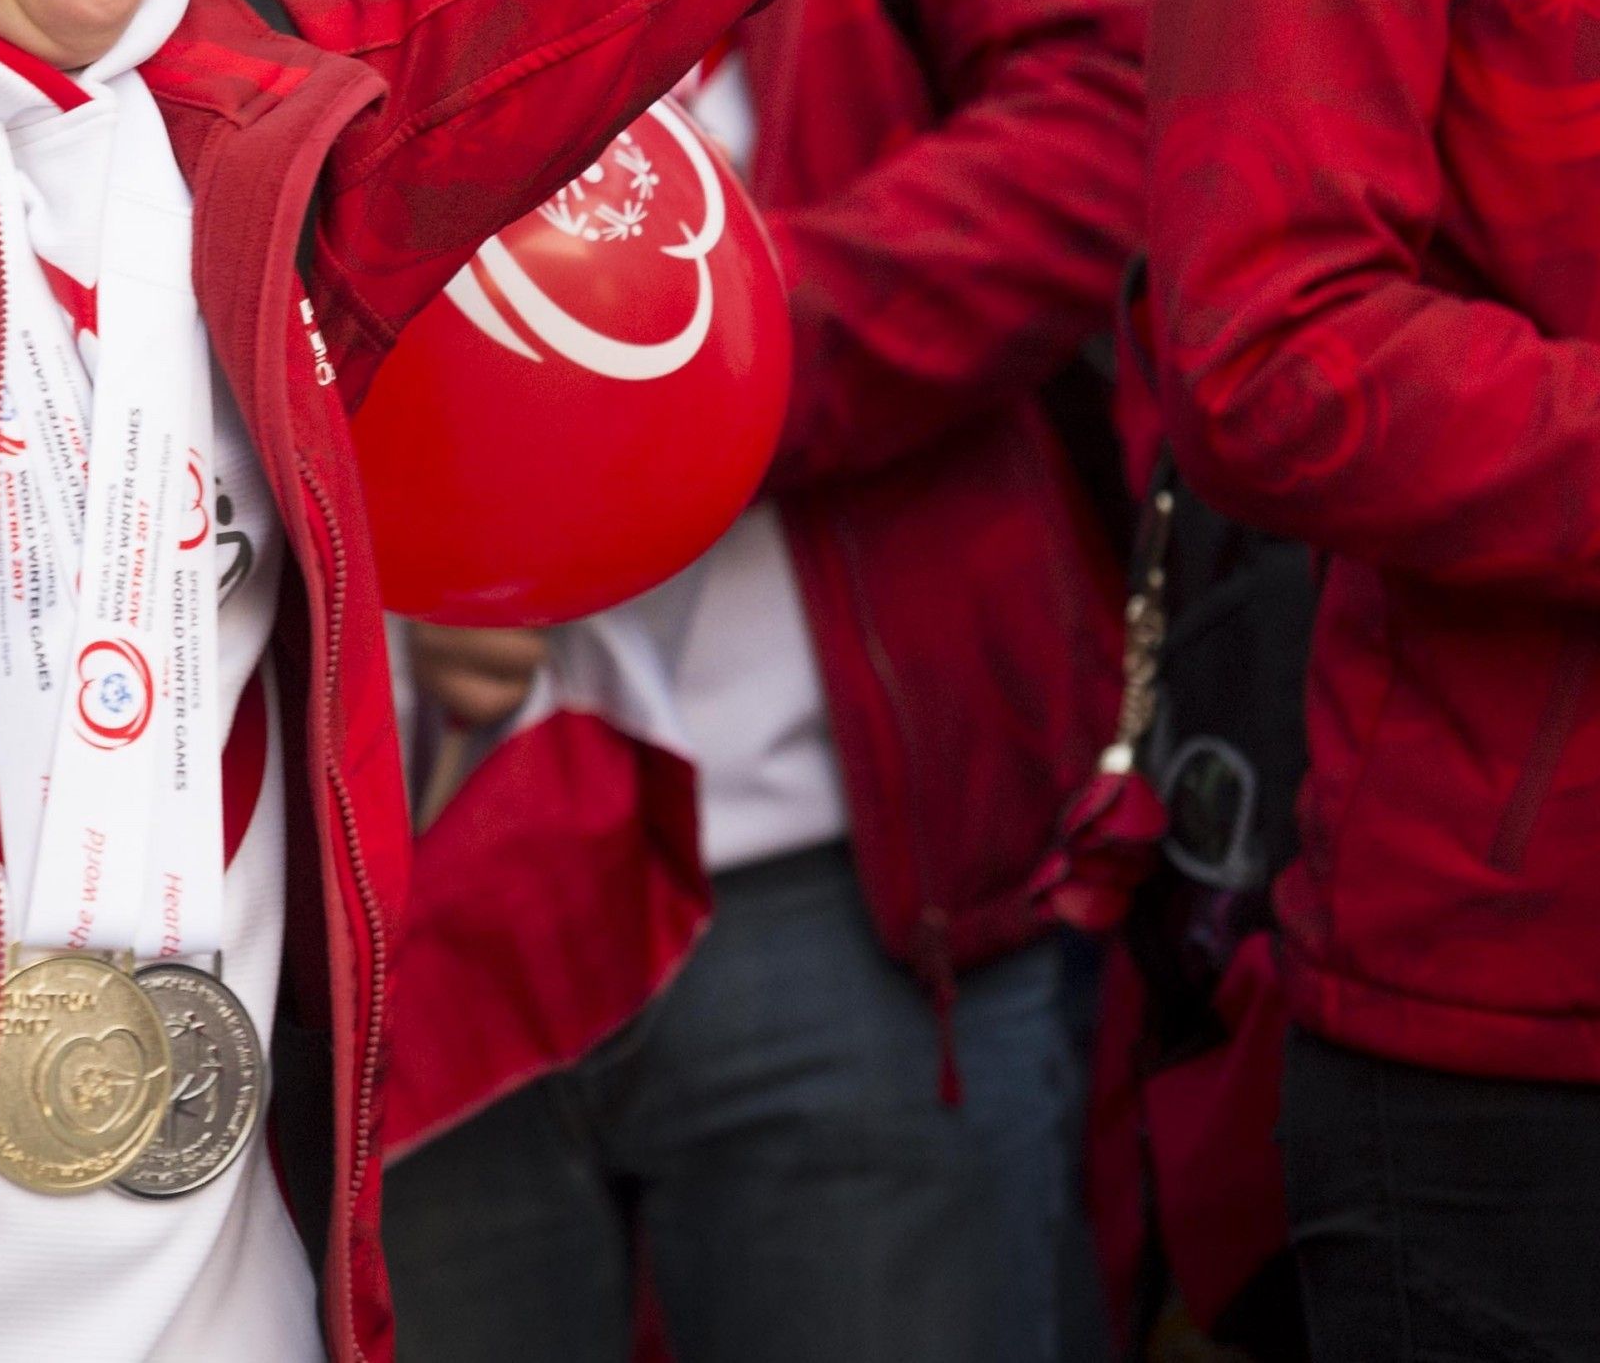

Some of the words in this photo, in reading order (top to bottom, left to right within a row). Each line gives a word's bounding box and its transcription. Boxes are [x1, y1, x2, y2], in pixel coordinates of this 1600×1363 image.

[20, 329, 50, 393] GAMES
[44, 398, 72, 470] WINTER
[125, 407, 142, 473] GAMES
[4, 470, 24, 553] AUSTRIA
[19, 469, 37, 540] WORLD
[101, 483, 118, 556] OLYMPICS
[119, 477, 137, 549] WINTER
[136, 498, 151, 543] 2017
[11, 559, 26, 603] 2017
[27, 545, 42, 620] WINTER
[43, 533, 57, 608] OLYMPICS
[96, 563, 112, 621] SPECIAL
[112, 554, 129, 623] WORLD
[127, 547, 146, 628] AUSTRIA
[173, 569, 187, 640] WORLD
[188, 570, 201, 629] SPECIAL
[29, 624, 54, 692] GAMES
[173, 645, 188, 719] WINTER
[189, 635, 201, 710] OLYMPICS
[173, 724, 189, 791] GAMES
[66, 910, 93, 950] the
[81, 826, 106, 902] world
